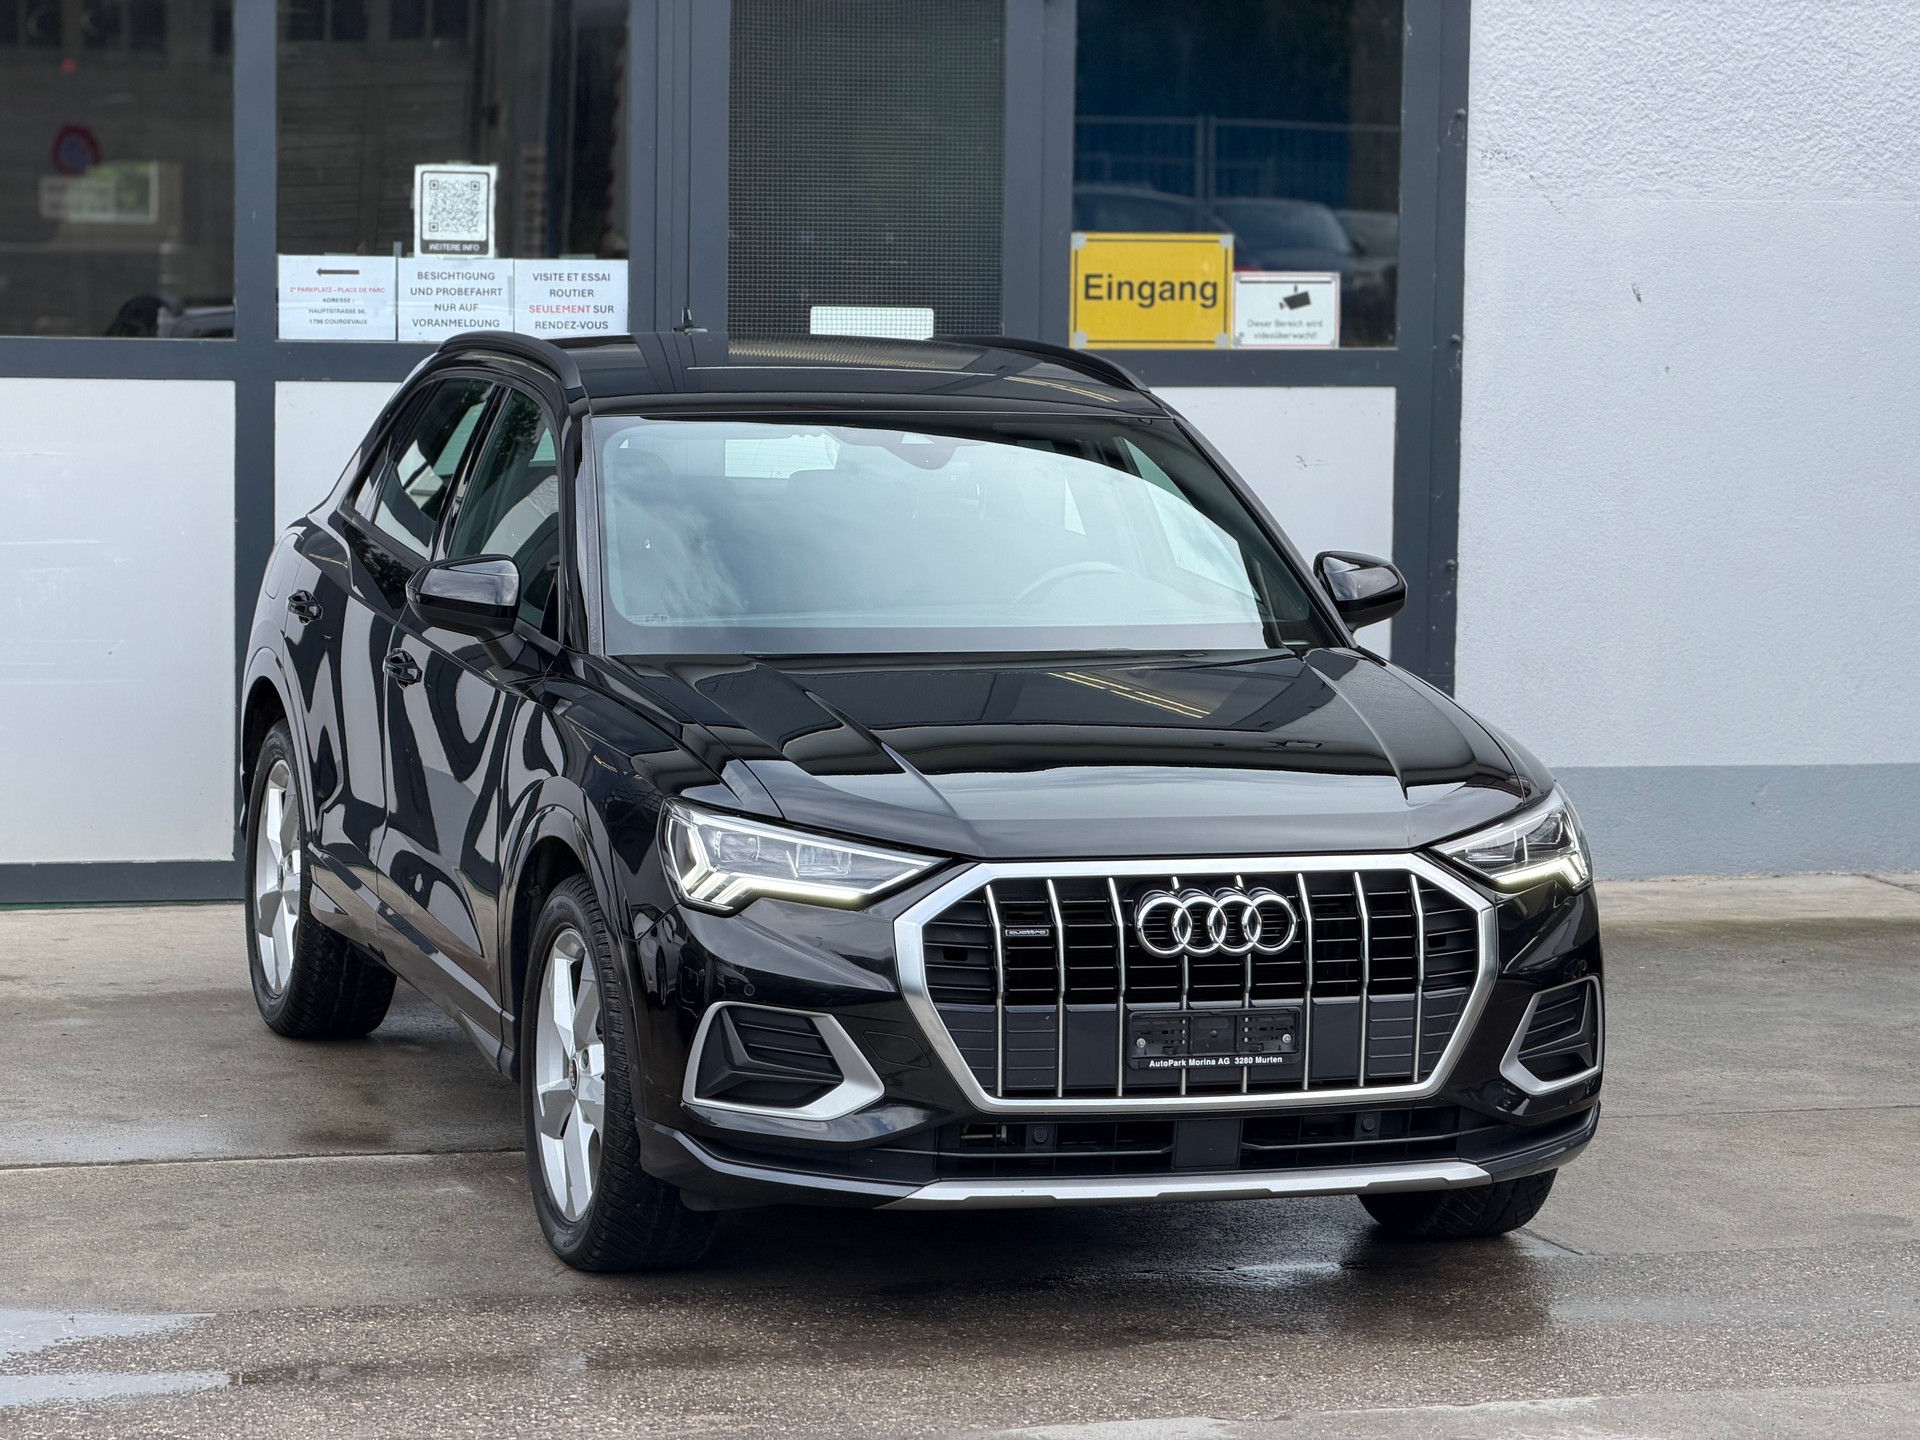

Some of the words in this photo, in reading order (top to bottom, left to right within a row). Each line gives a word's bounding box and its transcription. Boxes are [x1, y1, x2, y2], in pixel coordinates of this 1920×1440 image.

[429, 243, 461, 251] WEITERE
[417, 271, 496, 281] BESICHTIGUNG
[532, 272, 565, 282] VISITE
[567, 272, 579, 282] ET
[581, 272, 611, 282] ESSAI
[410, 287, 433, 296] UND
[436, 287, 503, 296] PROBEFAHRT
[549, 288, 594, 298] ROUTIER
[1084, 273, 1218, 309] Eingang
[434, 303, 457, 312] NUR
[458, 303, 479, 312] AUF
[529, 304, 591, 314] SEULEMENT
[593, 305, 614, 314] SUR
[412, 318, 500, 328] VORANMELDUNG
[535, 320, 609, 330] RENDEZ-VOUS
[1247, 319, 1272, 327] Dieser
[1275, 319, 1304, 328] Bereich
[1306, 319, 1323, 328] wird
[1149, 1059, 1187, 1068] AutoPark
[1188, 1058, 1215, 1067] Morina
[1217, 1057, 1230, 1065] AG
[1234, 1056, 1253, 1065] 3280
[1255, 1056, 1283, 1064] Murten
